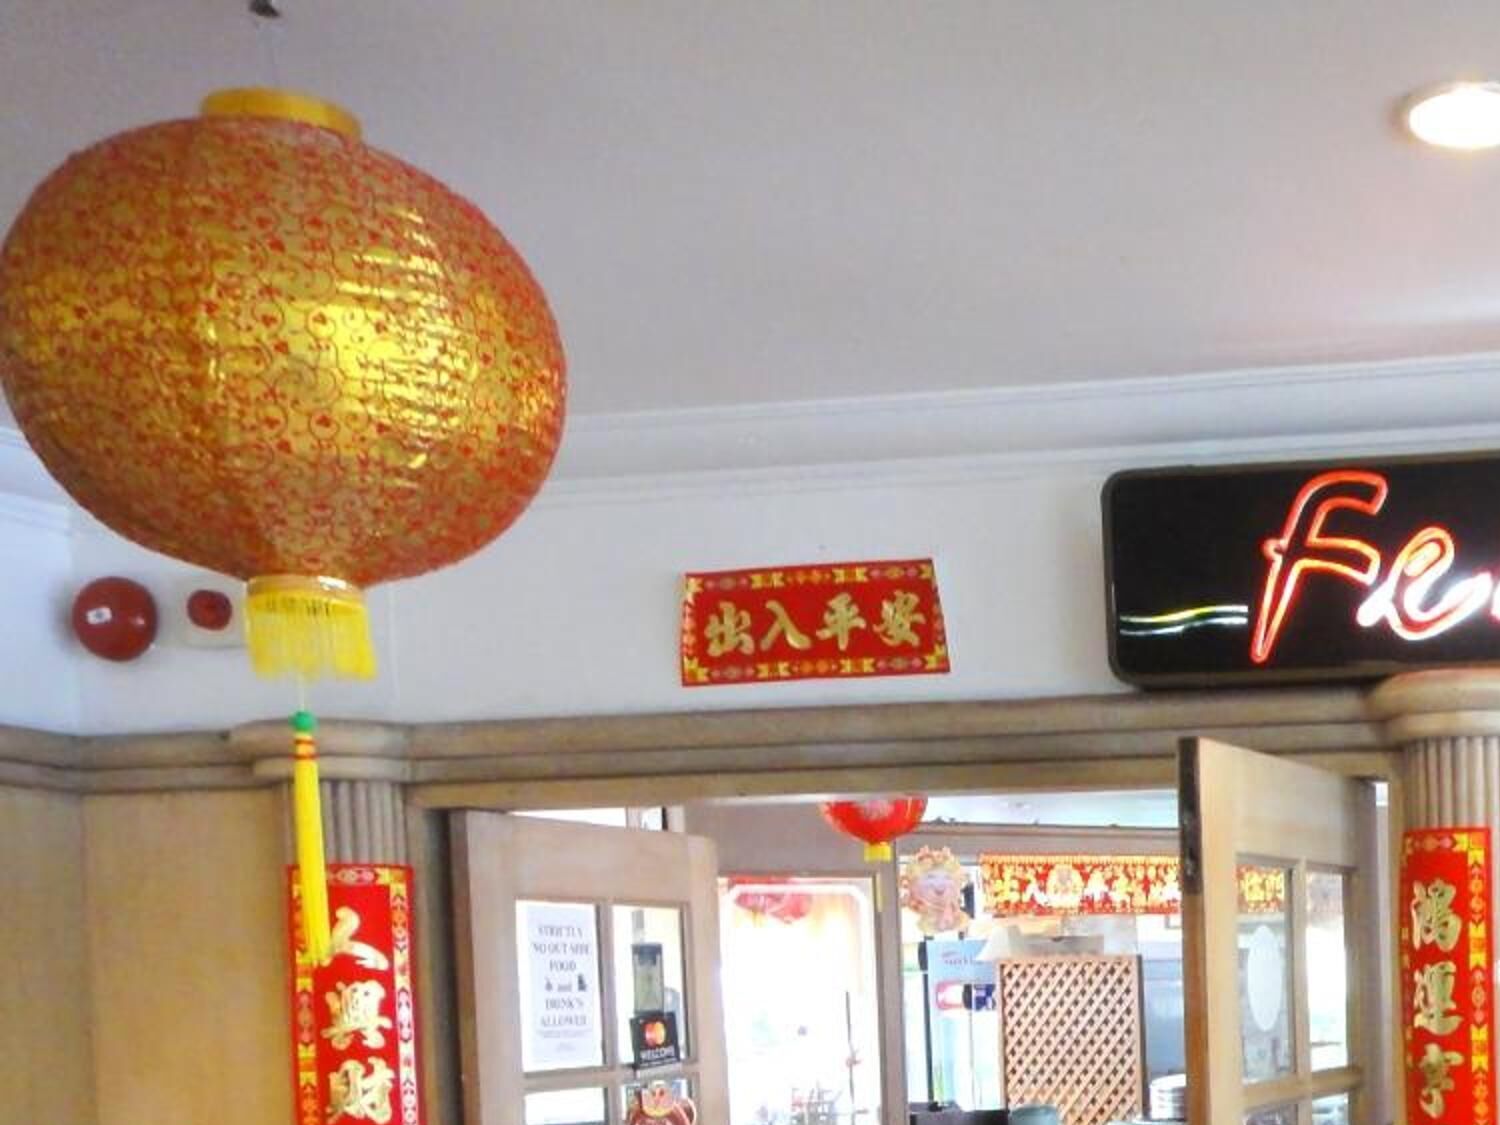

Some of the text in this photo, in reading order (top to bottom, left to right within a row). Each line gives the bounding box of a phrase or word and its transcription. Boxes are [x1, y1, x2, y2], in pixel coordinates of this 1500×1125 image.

[703, 589, 926, 657] 出入平安
[549, 960, 577, 972] FOOD
